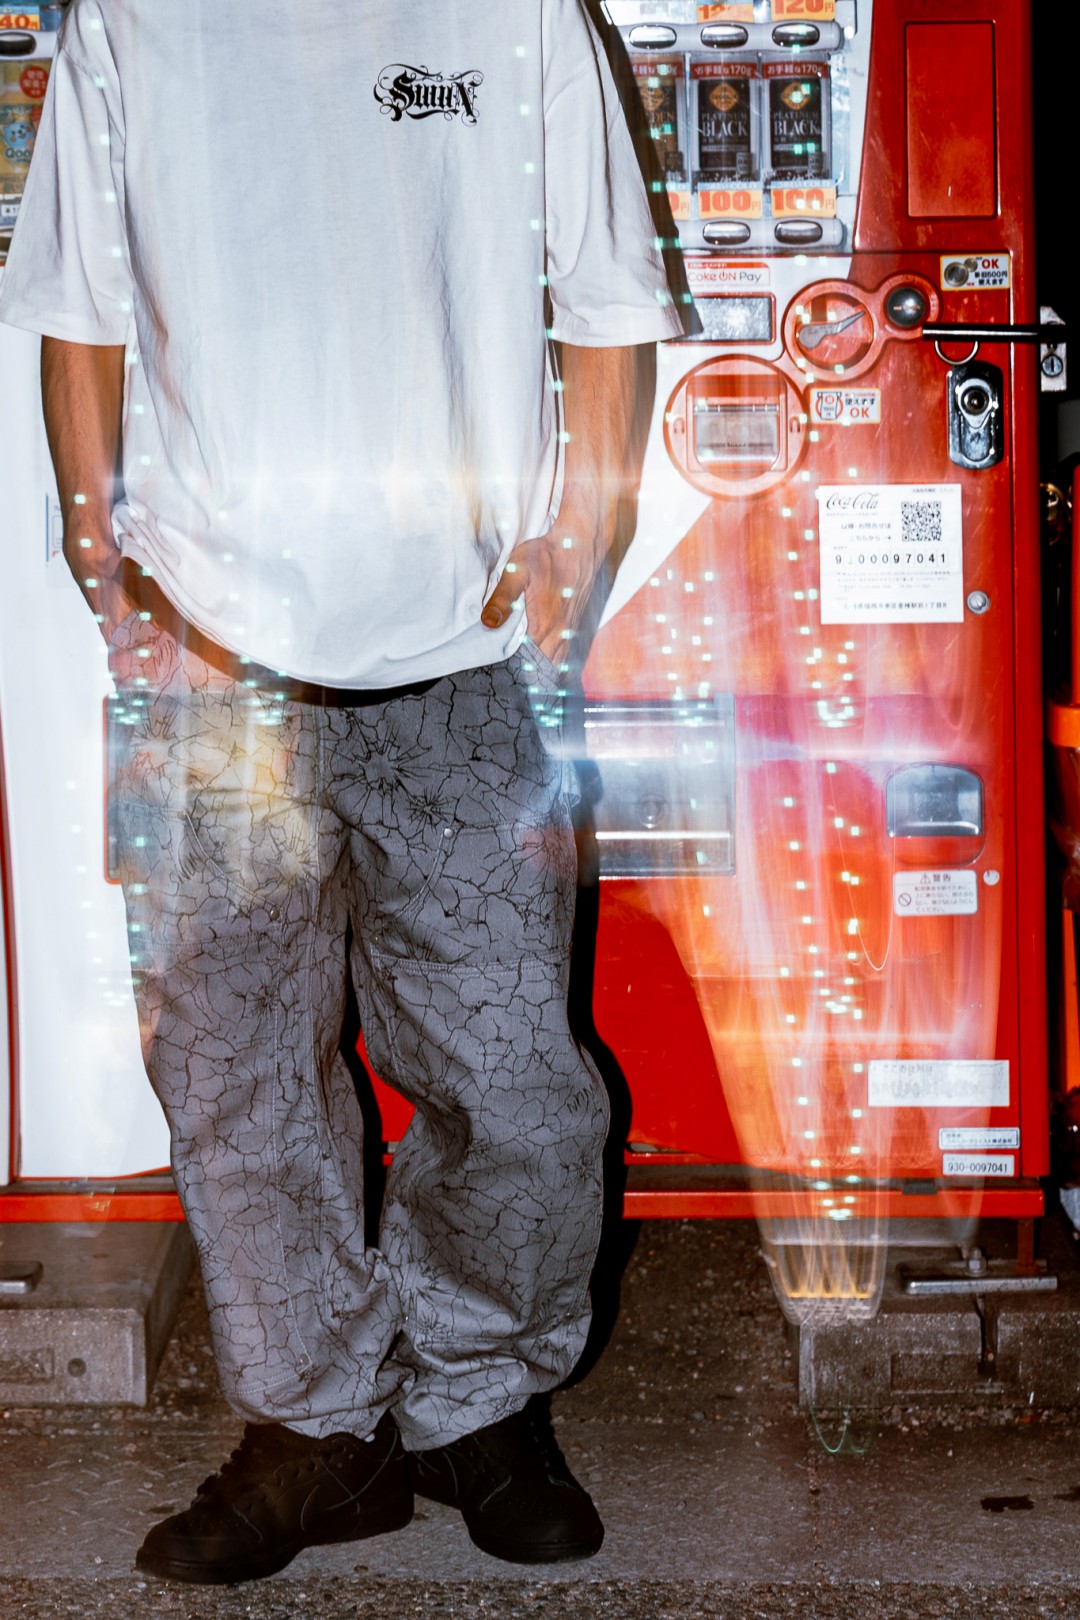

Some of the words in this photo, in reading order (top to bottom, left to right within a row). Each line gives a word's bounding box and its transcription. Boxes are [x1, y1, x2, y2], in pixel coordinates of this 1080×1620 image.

[695, 64, 752, 76] お手軽な170g
[702, 120, 748, 136] BLACK
[774, 119, 820, 136] BLACK
[700, 190, 761, 212] 100円
[773, 188, 834, 211] 100円
[982, 258, 999, 269] OK
[688, 271, 716, 281] Coke
[719, 270, 737, 281] ON
[739, 271, 762, 284] Pay
[979, 278, 1004, 286] 使えます
[850, 407, 869, 418] OK
[932, 873, 951, 882] 警告
[948, 1162, 1008, 1173] 930-0097041
